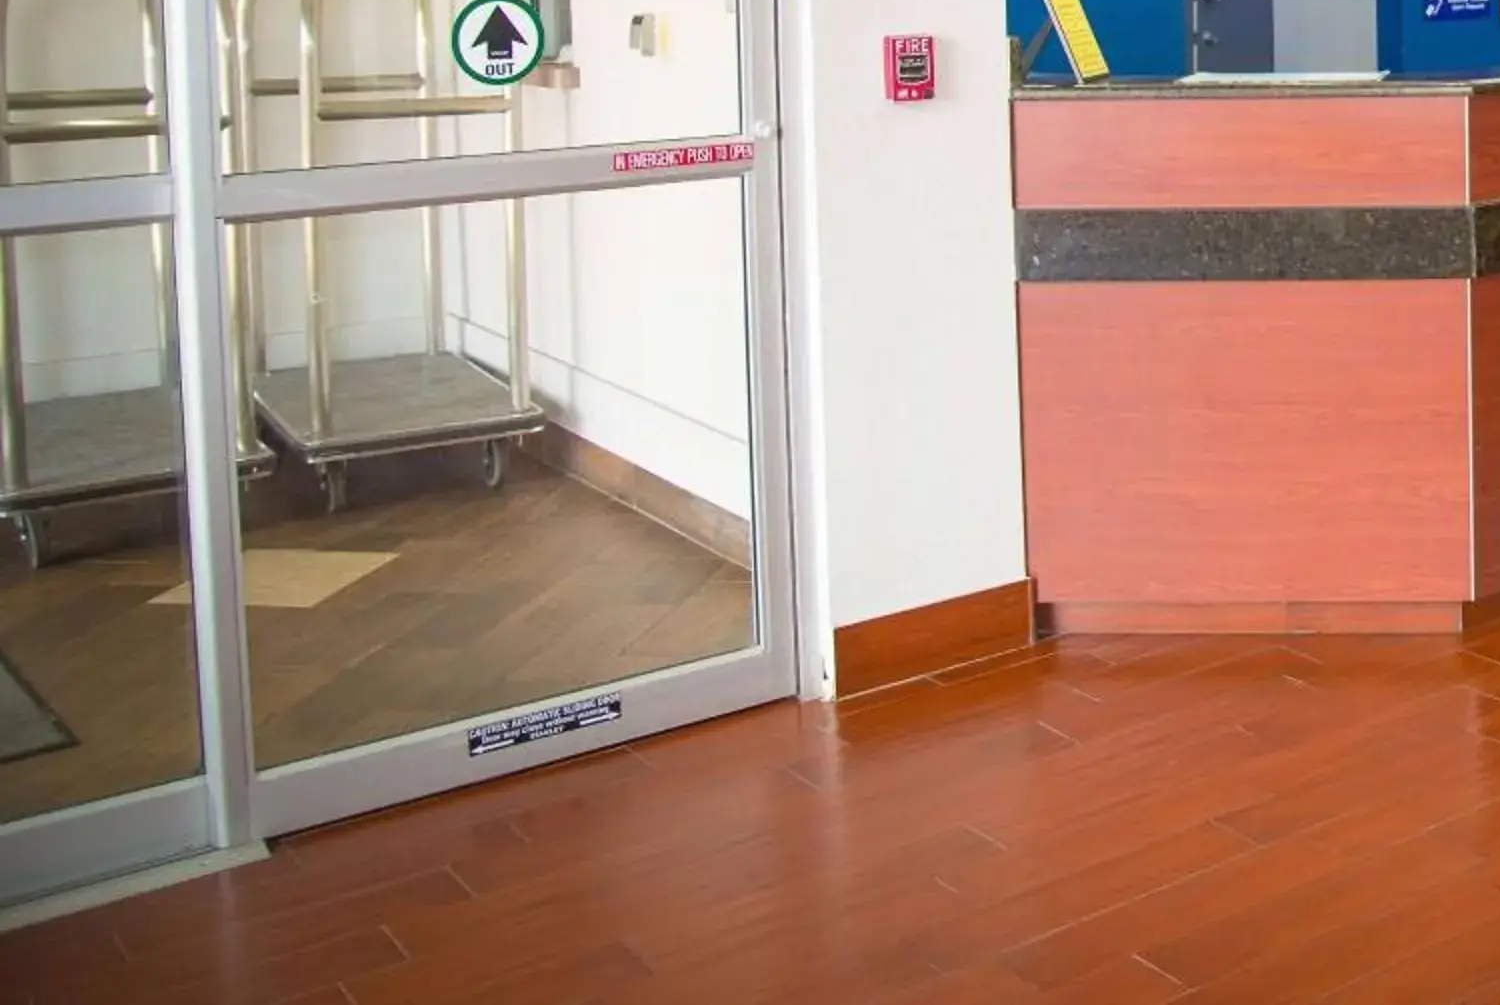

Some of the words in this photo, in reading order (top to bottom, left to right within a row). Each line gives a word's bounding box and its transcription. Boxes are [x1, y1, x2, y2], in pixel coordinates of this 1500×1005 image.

[895, 38, 930, 53] FIRE
[485, 62, 516, 76] OUT
[615, 154, 626, 170] IN
[628, 149, 685, 168] EMERGENCY
[687, 146, 713, 164] PUSH
[729, 144, 753, 160] OPEN
